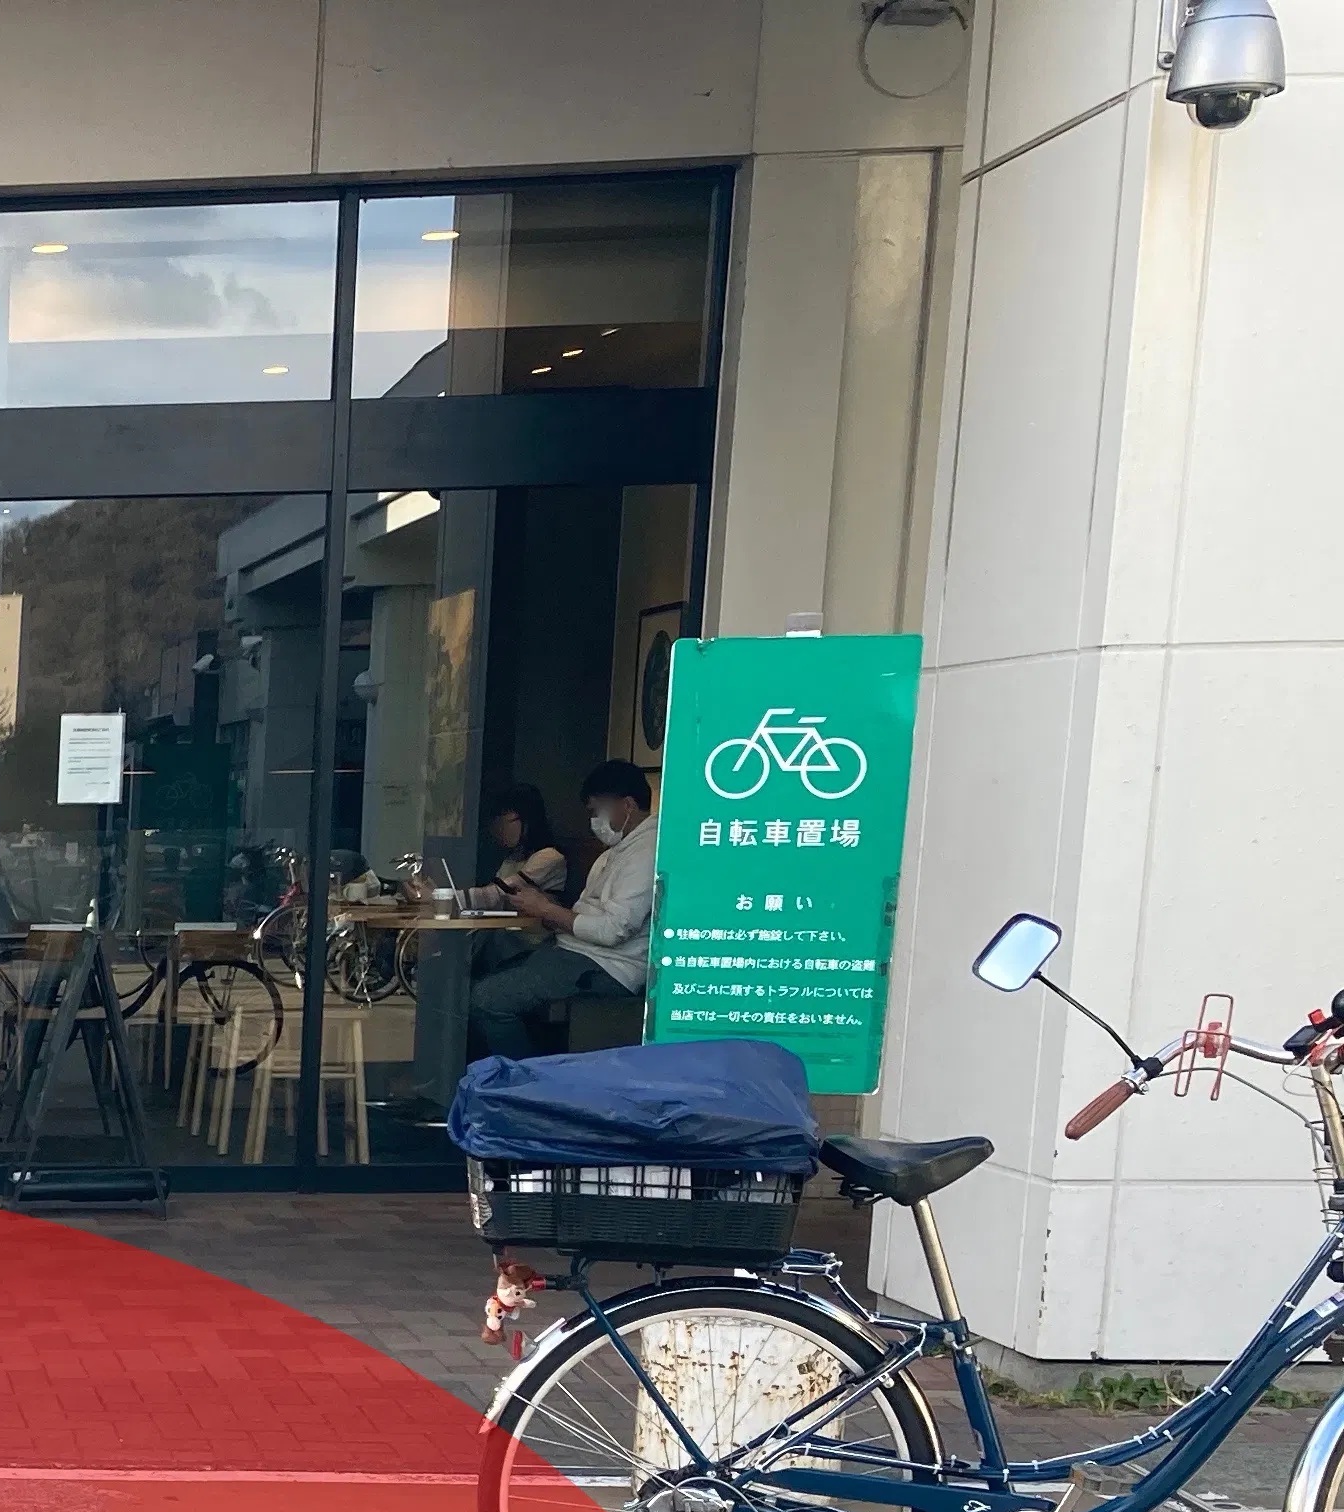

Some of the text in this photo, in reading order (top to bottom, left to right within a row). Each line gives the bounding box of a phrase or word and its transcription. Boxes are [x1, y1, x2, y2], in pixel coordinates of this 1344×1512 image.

[698, 818, 861, 848] 自転車置場
[735, 894, 814, 912] お願い
